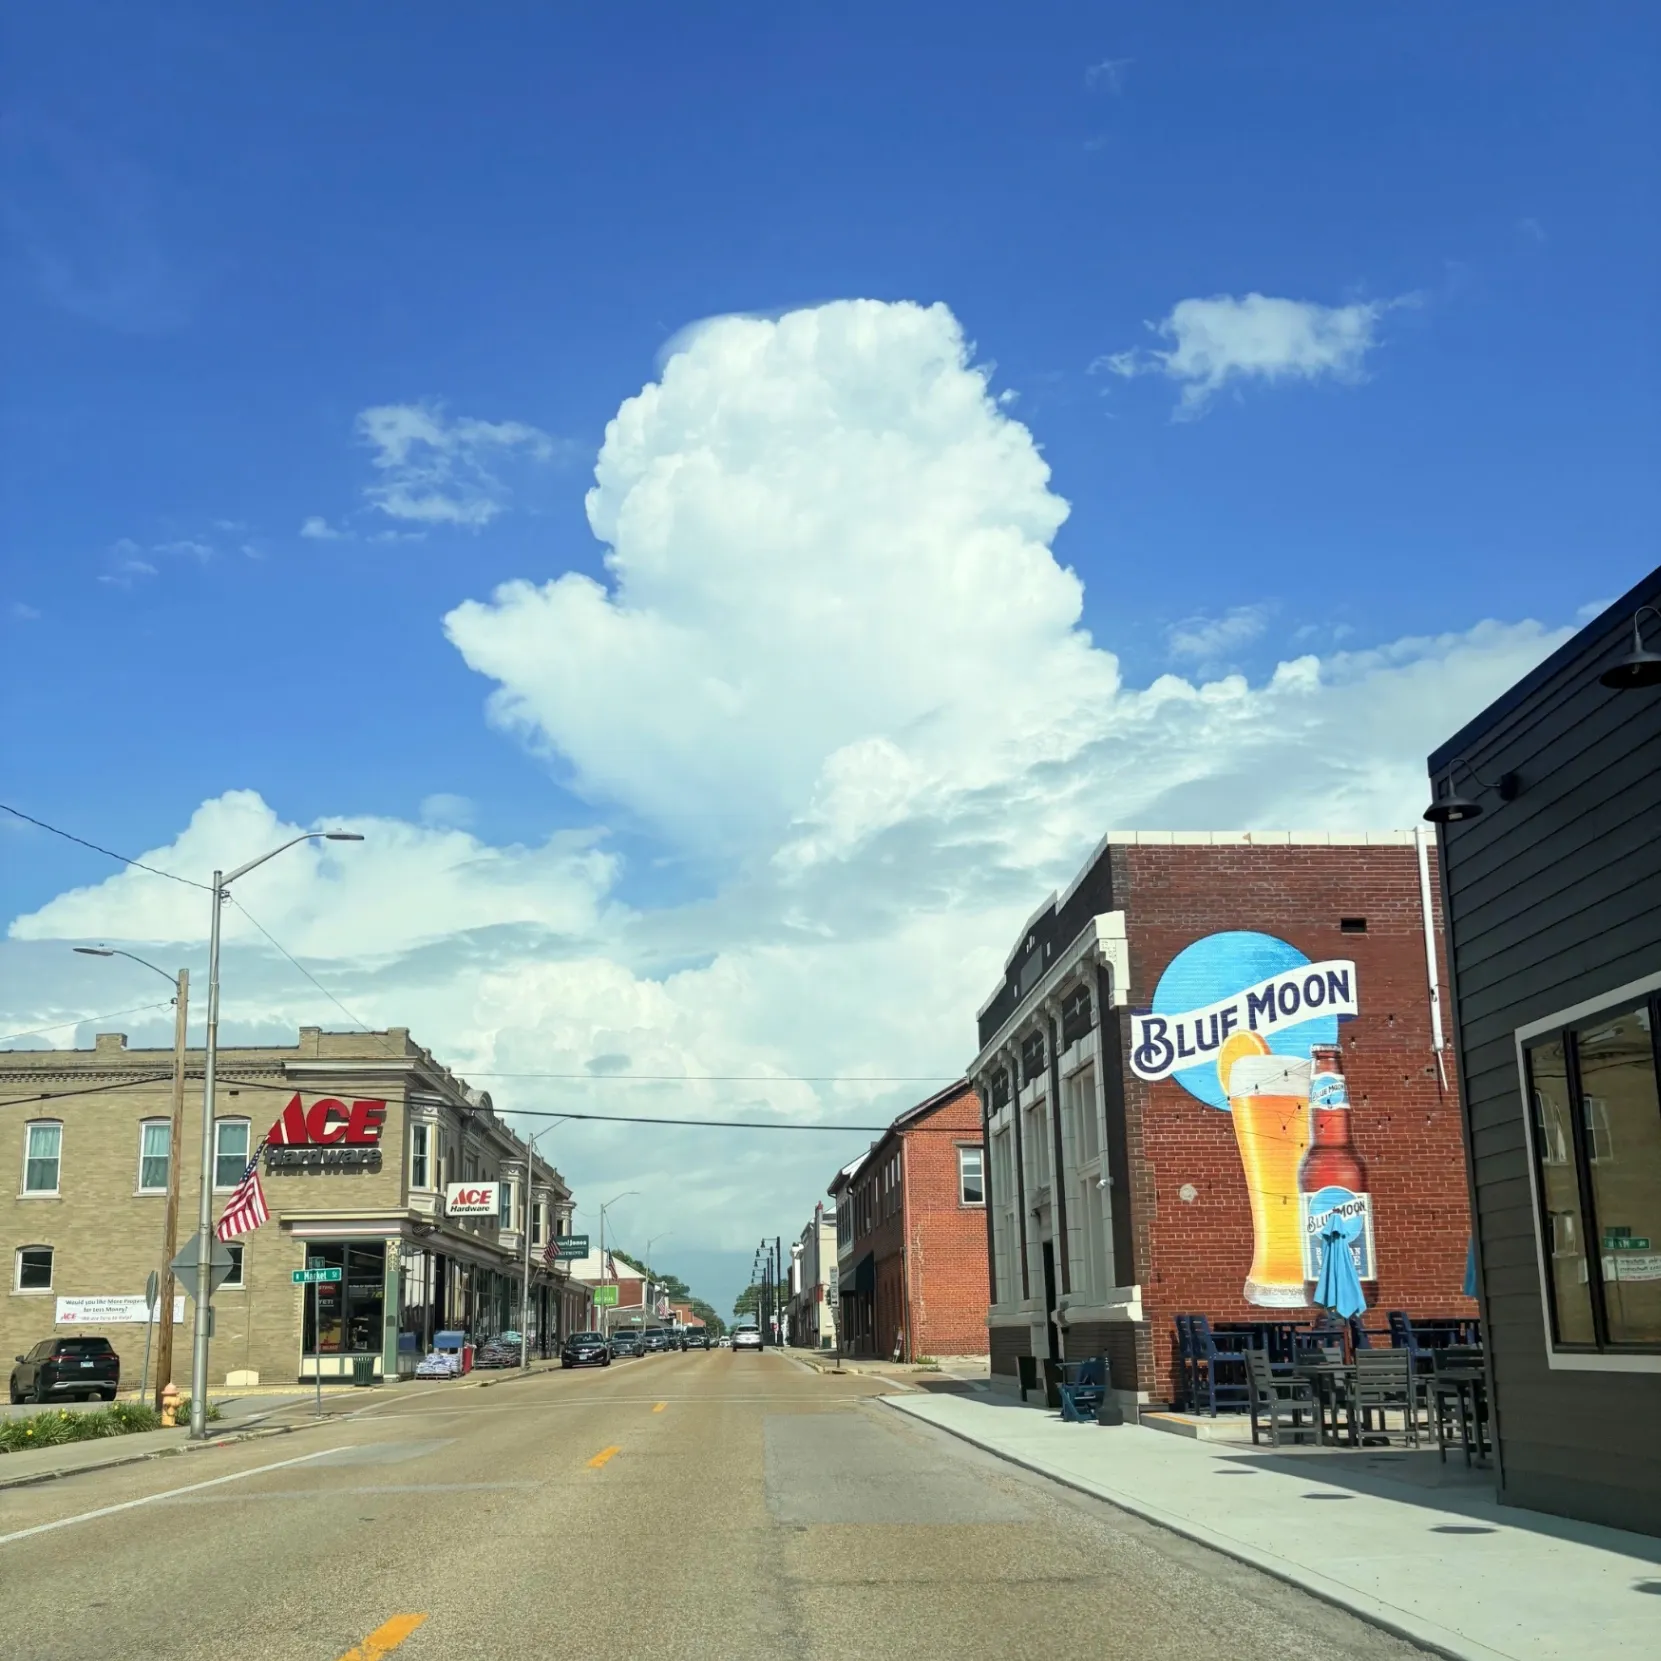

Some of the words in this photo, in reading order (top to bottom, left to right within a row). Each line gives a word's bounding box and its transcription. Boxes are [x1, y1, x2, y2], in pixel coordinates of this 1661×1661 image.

[1134, 1005, 1238, 1073] BLUE
[1246, 970, 1350, 1030] MOON
[264, 1091, 387, 1145] ACE
[263, 1146, 382, 1166] Hardware
[451, 1188, 493, 1205] ACE
[304, 1271, 327, 1281] Market
[331, 1270, 338, 1278] St
